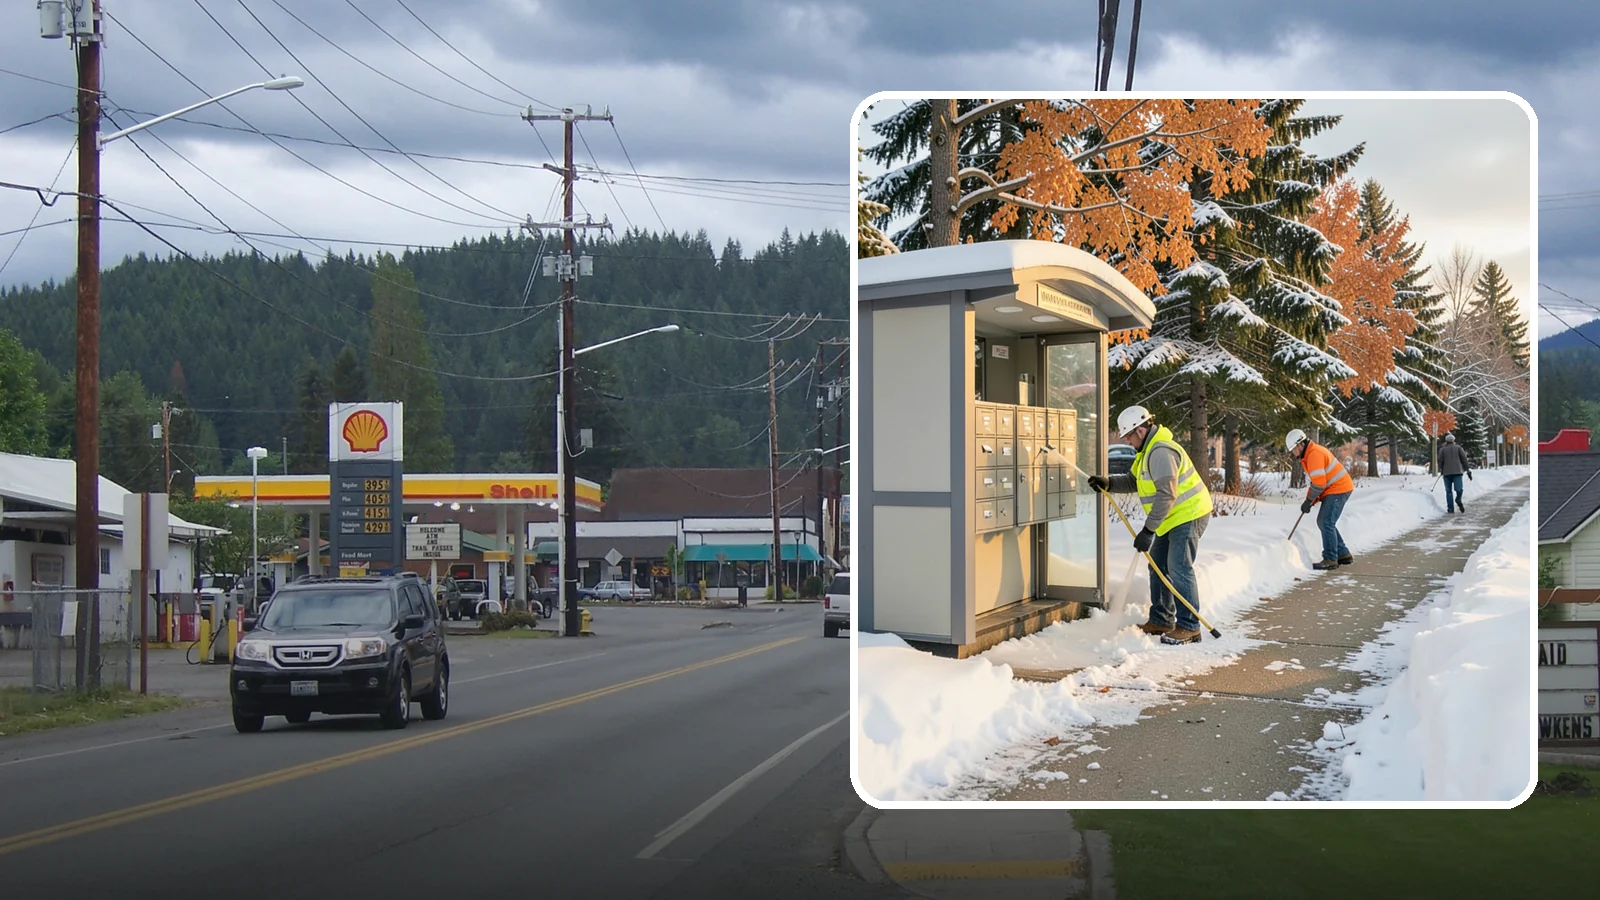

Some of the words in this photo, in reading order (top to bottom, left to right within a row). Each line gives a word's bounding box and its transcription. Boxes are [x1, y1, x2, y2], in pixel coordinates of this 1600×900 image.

[366, 480, 383, 490] 395
[490, 484, 547, 499] Shell
[366, 494, 383, 504] 405
[366, 508, 383, 518] 415
[366, 522, 383, 532] 429
